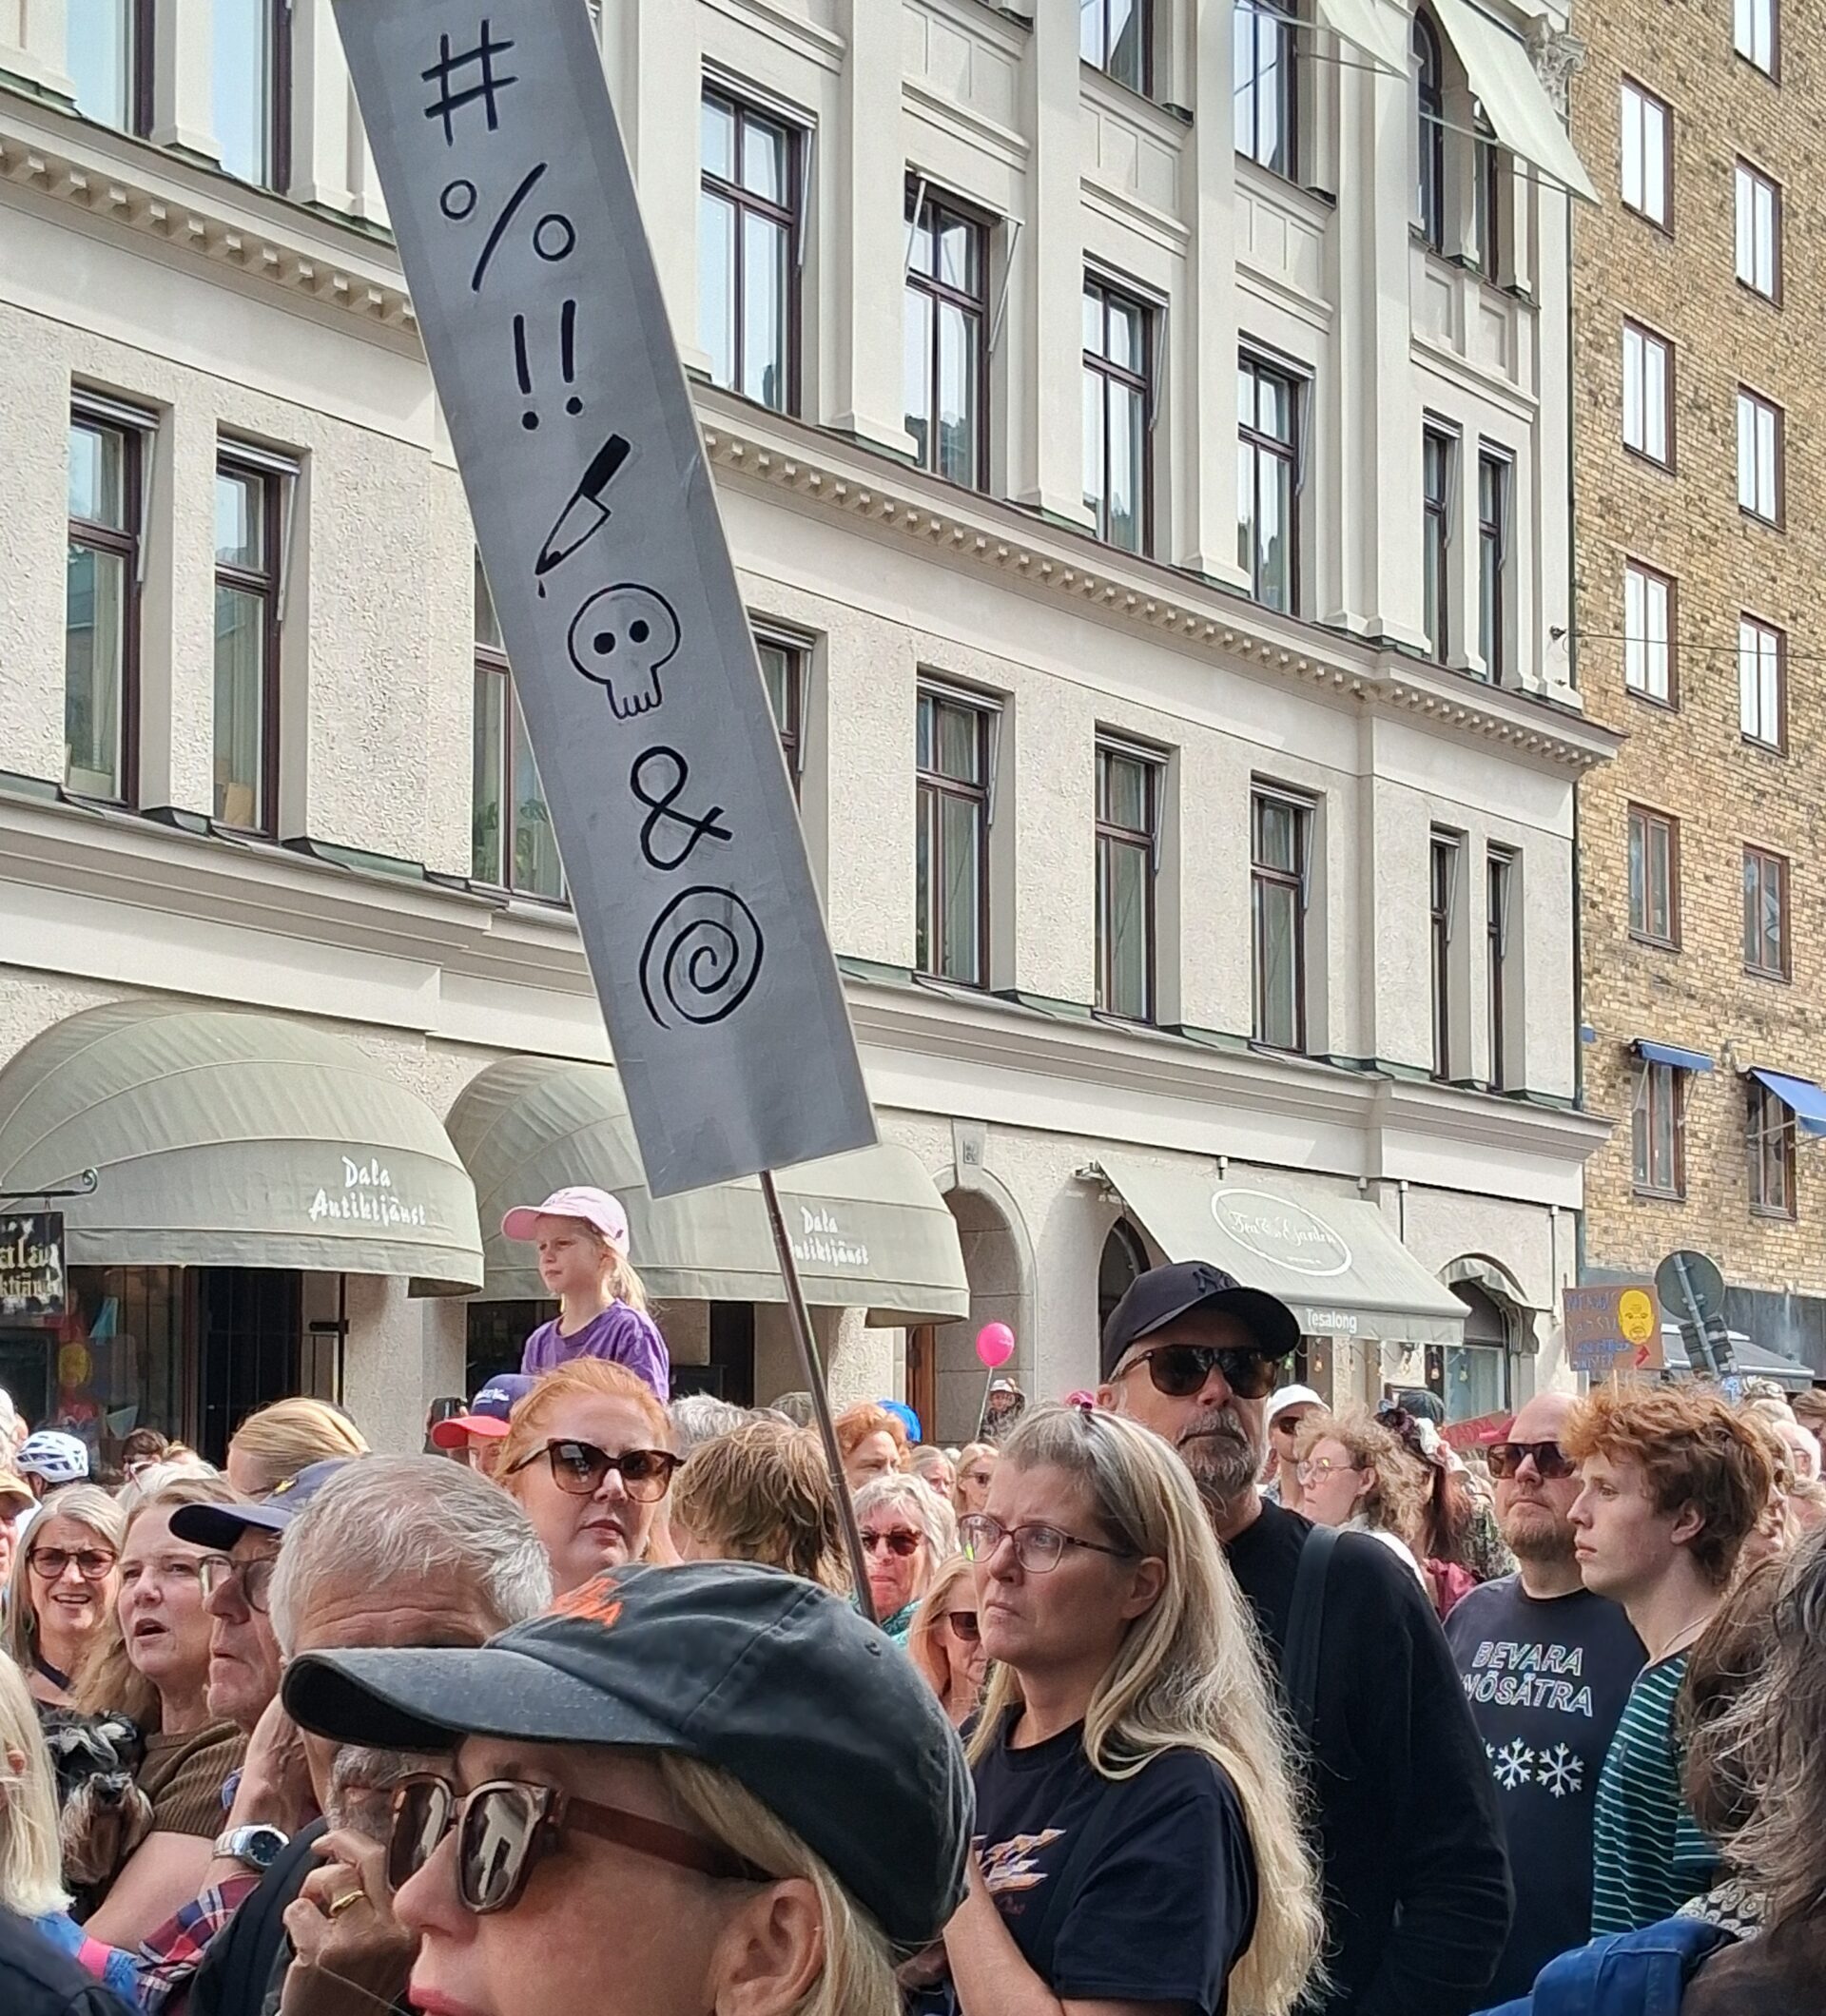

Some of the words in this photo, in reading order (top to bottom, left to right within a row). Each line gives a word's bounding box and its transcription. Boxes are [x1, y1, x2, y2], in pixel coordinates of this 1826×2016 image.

[341, 1155, 391, 1188] Dala
[308, 1188, 426, 1227] Antiktjänst
[800, 1206, 838, 1234] Dala
[0, 1237, 49, 1270] ala
[793, 1236, 869, 1267] ntiktjänst
[1306, 1308, 1357, 1334] Tesalong
[1472, 1641, 1583, 1677] BEVARA
[1461, 1671, 1593, 1717] NÖSÄTRA
